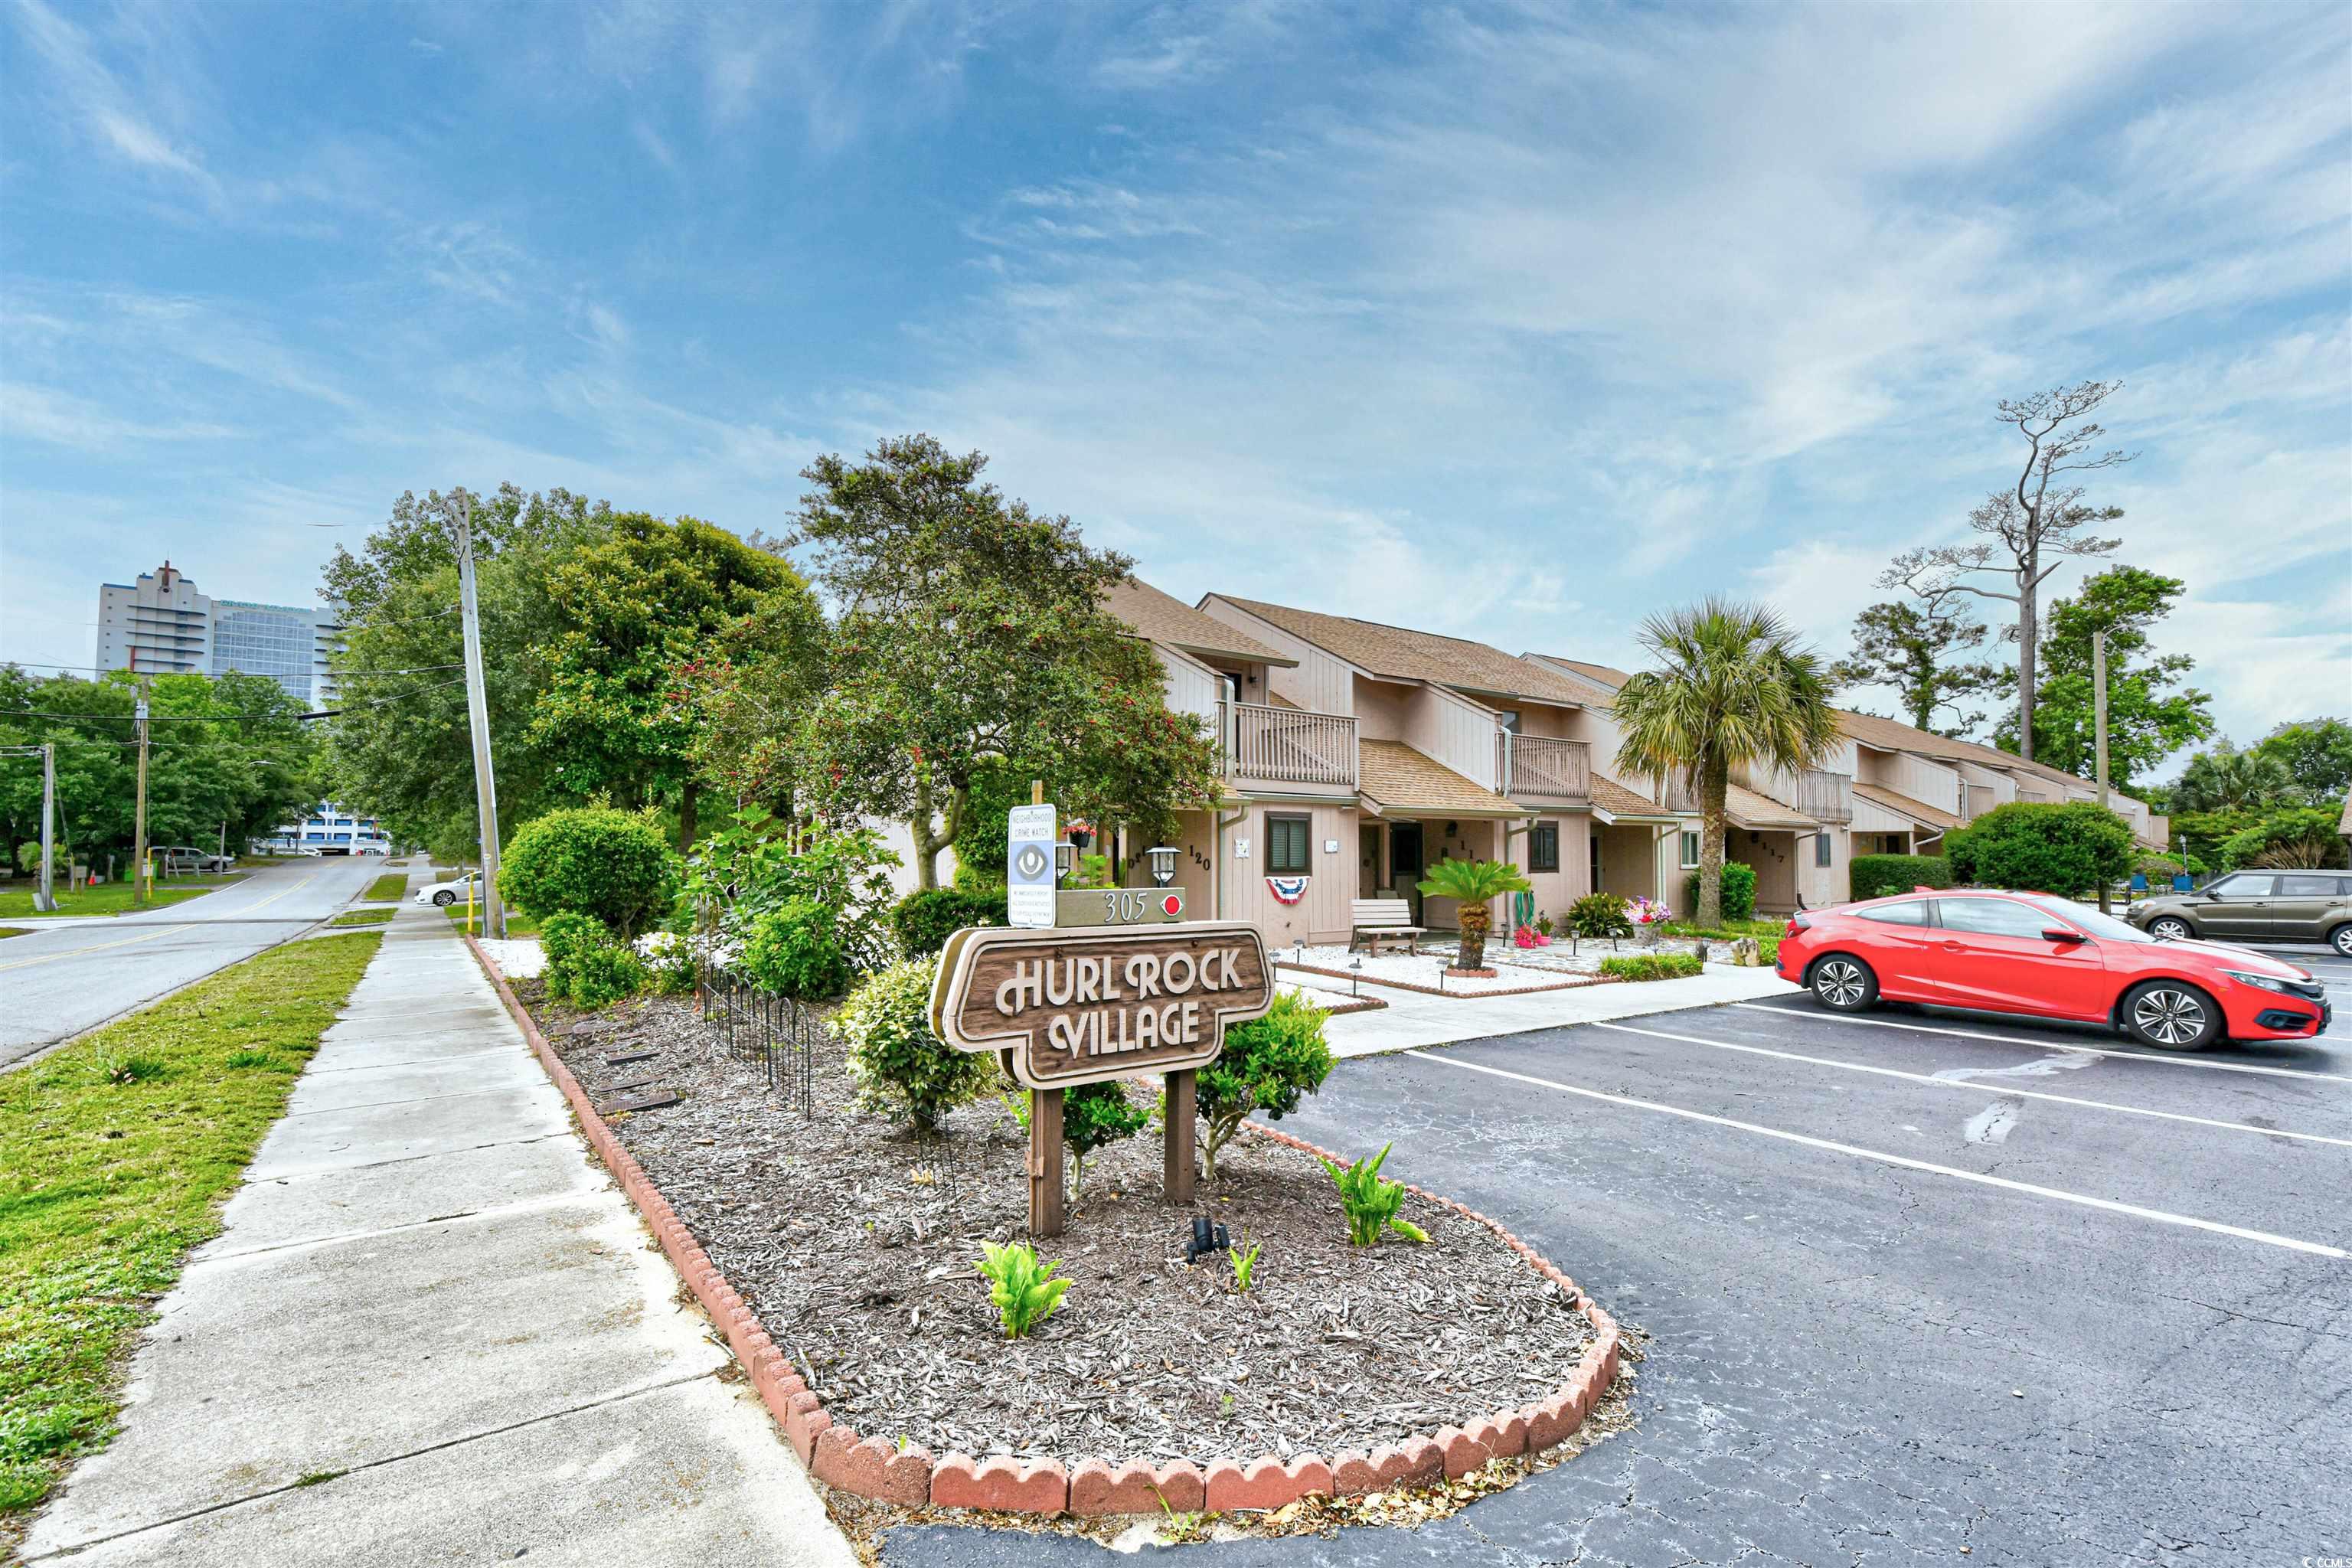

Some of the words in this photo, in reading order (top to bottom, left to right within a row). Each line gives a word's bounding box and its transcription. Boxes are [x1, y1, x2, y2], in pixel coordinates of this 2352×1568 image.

[1013, 813, 1052, 824] NEIGHBORHOOD
[1014, 827, 1030, 838] CRIME
[1032, 827, 1049, 838] WATCH
[1189, 845, 1210, 871] 120
[1762, 841, 1784, 863] 117
[1105, 893, 1148, 922] 305
[995, 956, 1121, 1017] HURL
[1125, 948, 1243, 1000] ROCK
[1048, 1001, 1199, 1060] VILLAGE
